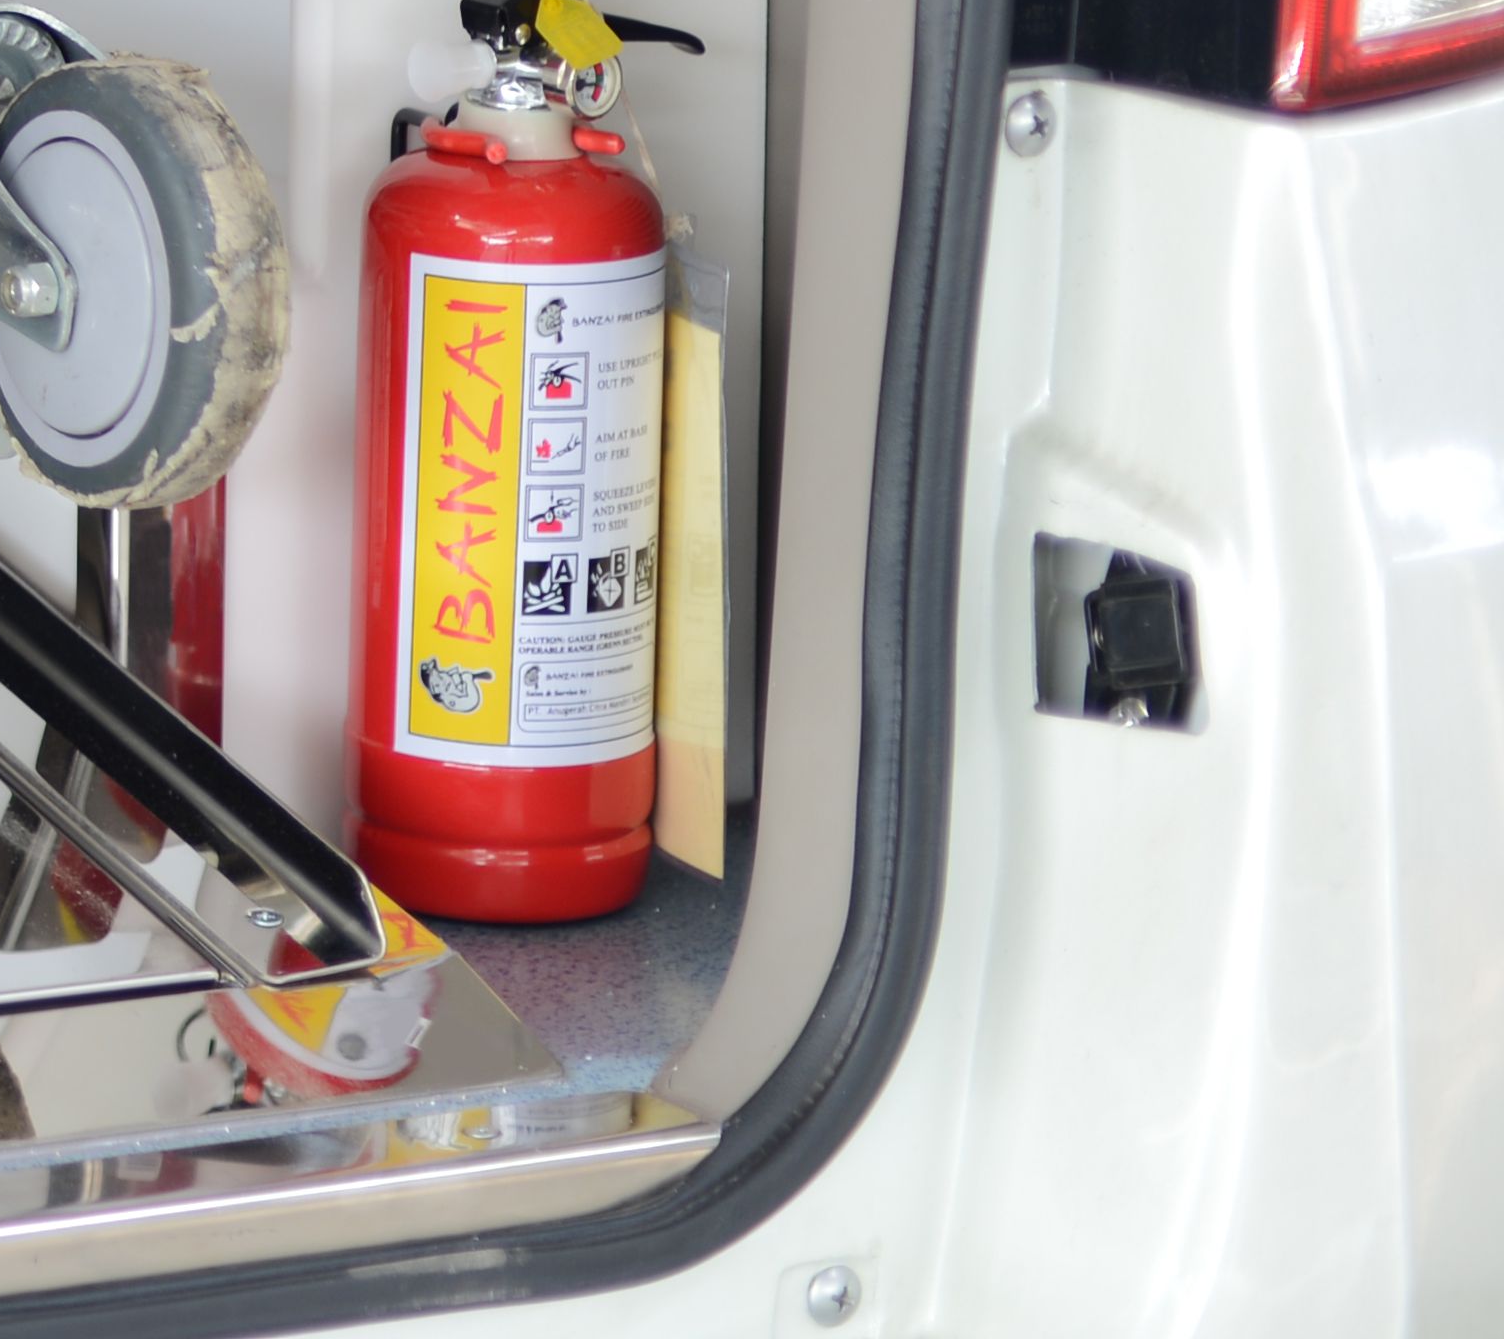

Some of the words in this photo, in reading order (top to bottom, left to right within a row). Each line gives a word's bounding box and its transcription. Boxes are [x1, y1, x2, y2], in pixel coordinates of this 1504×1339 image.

[572, 314, 615, 328] BANZAI
[598, 361, 617, 373] USE
[597, 378, 618, 391] OUT
[595, 432, 616, 444] AIM
[617, 429, 629, 441] AT
[594, 451, 608, 463] OF
[434, 298, 508, 645] BANZAI
[592, 506, 615, 518] AND
[592, 522, 606, 533] TO
[554, 559, 573, 580] A
[614, 553, 626, 575] B
